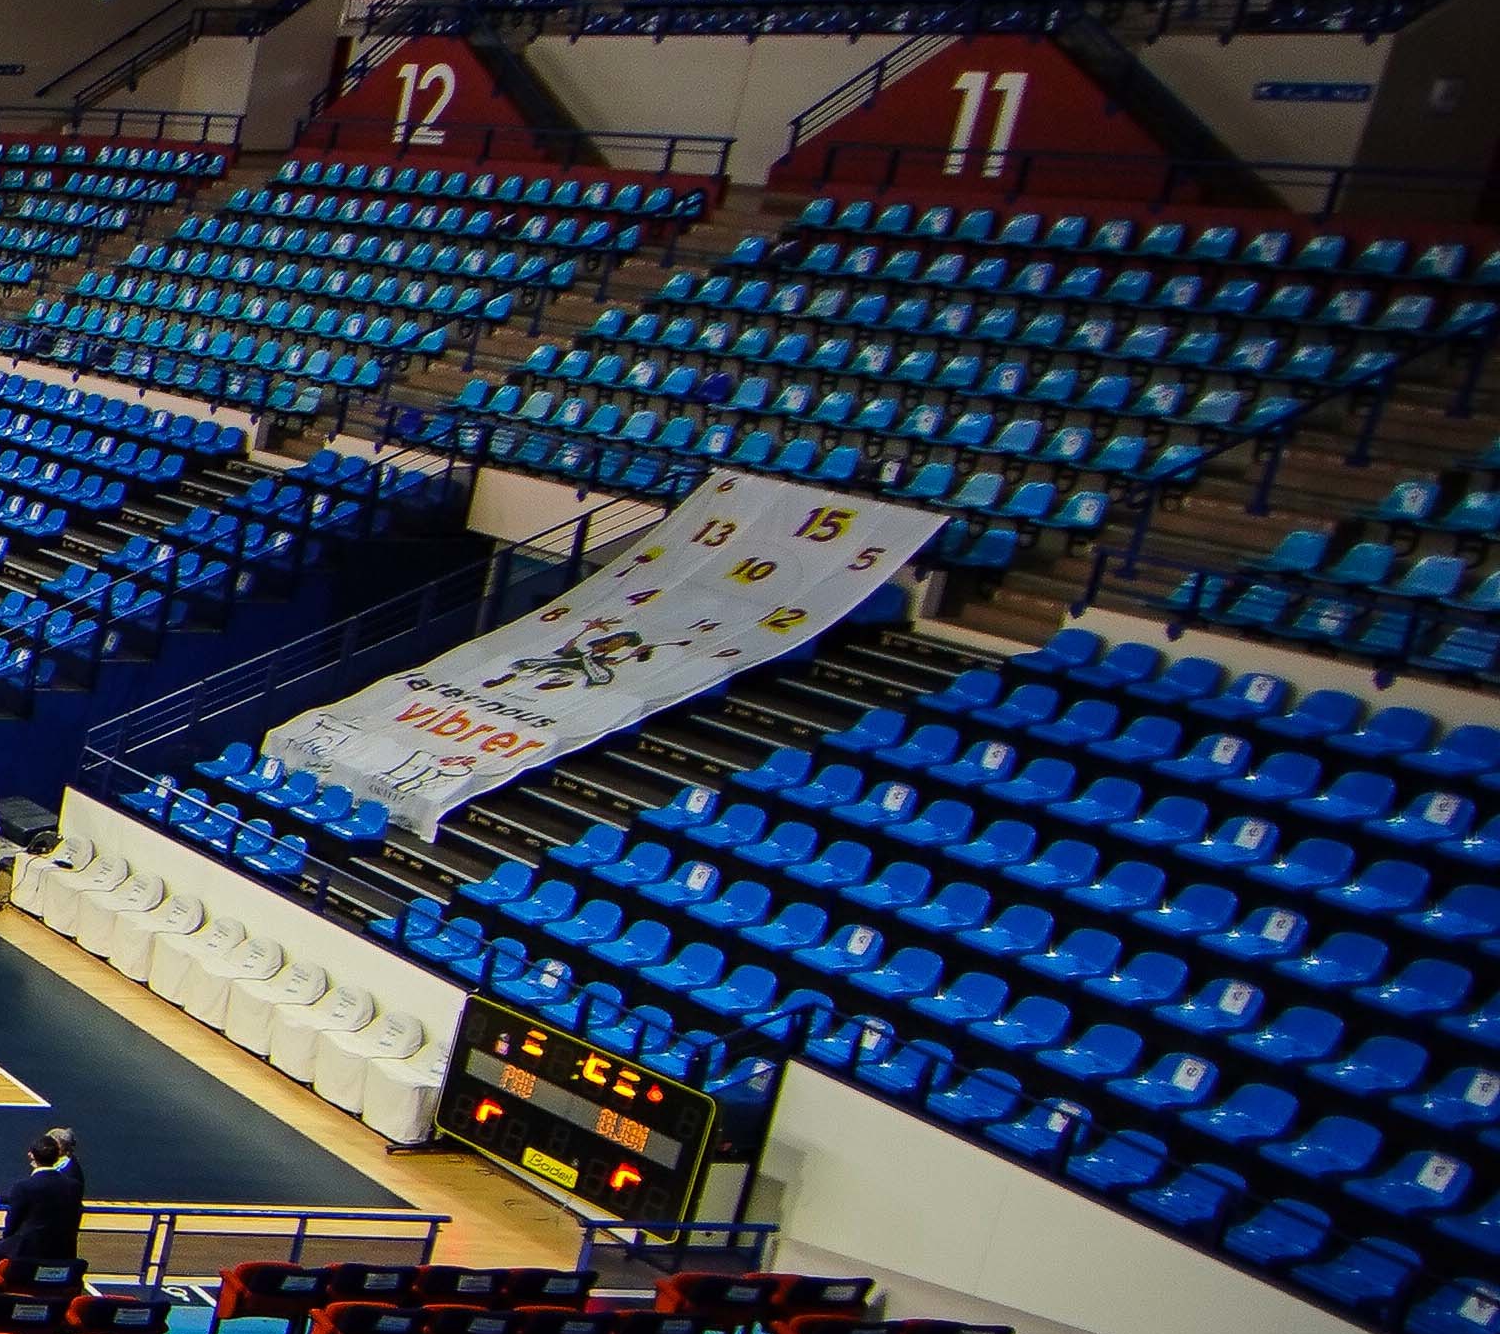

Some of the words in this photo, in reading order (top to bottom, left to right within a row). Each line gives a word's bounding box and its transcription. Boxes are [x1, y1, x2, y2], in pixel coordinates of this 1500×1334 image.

[393, 62, 456, 145] 12
[941, 71, 1029, 178] 11
[717, 477, 739, 495] 6
[691, 520, 737, 548] 13
[794, 506, 855, 542] 15
[733, 556, 778, 582] 10
[848, 546, 886, 571] 5
[396, 702, 546, 758] vibrer
